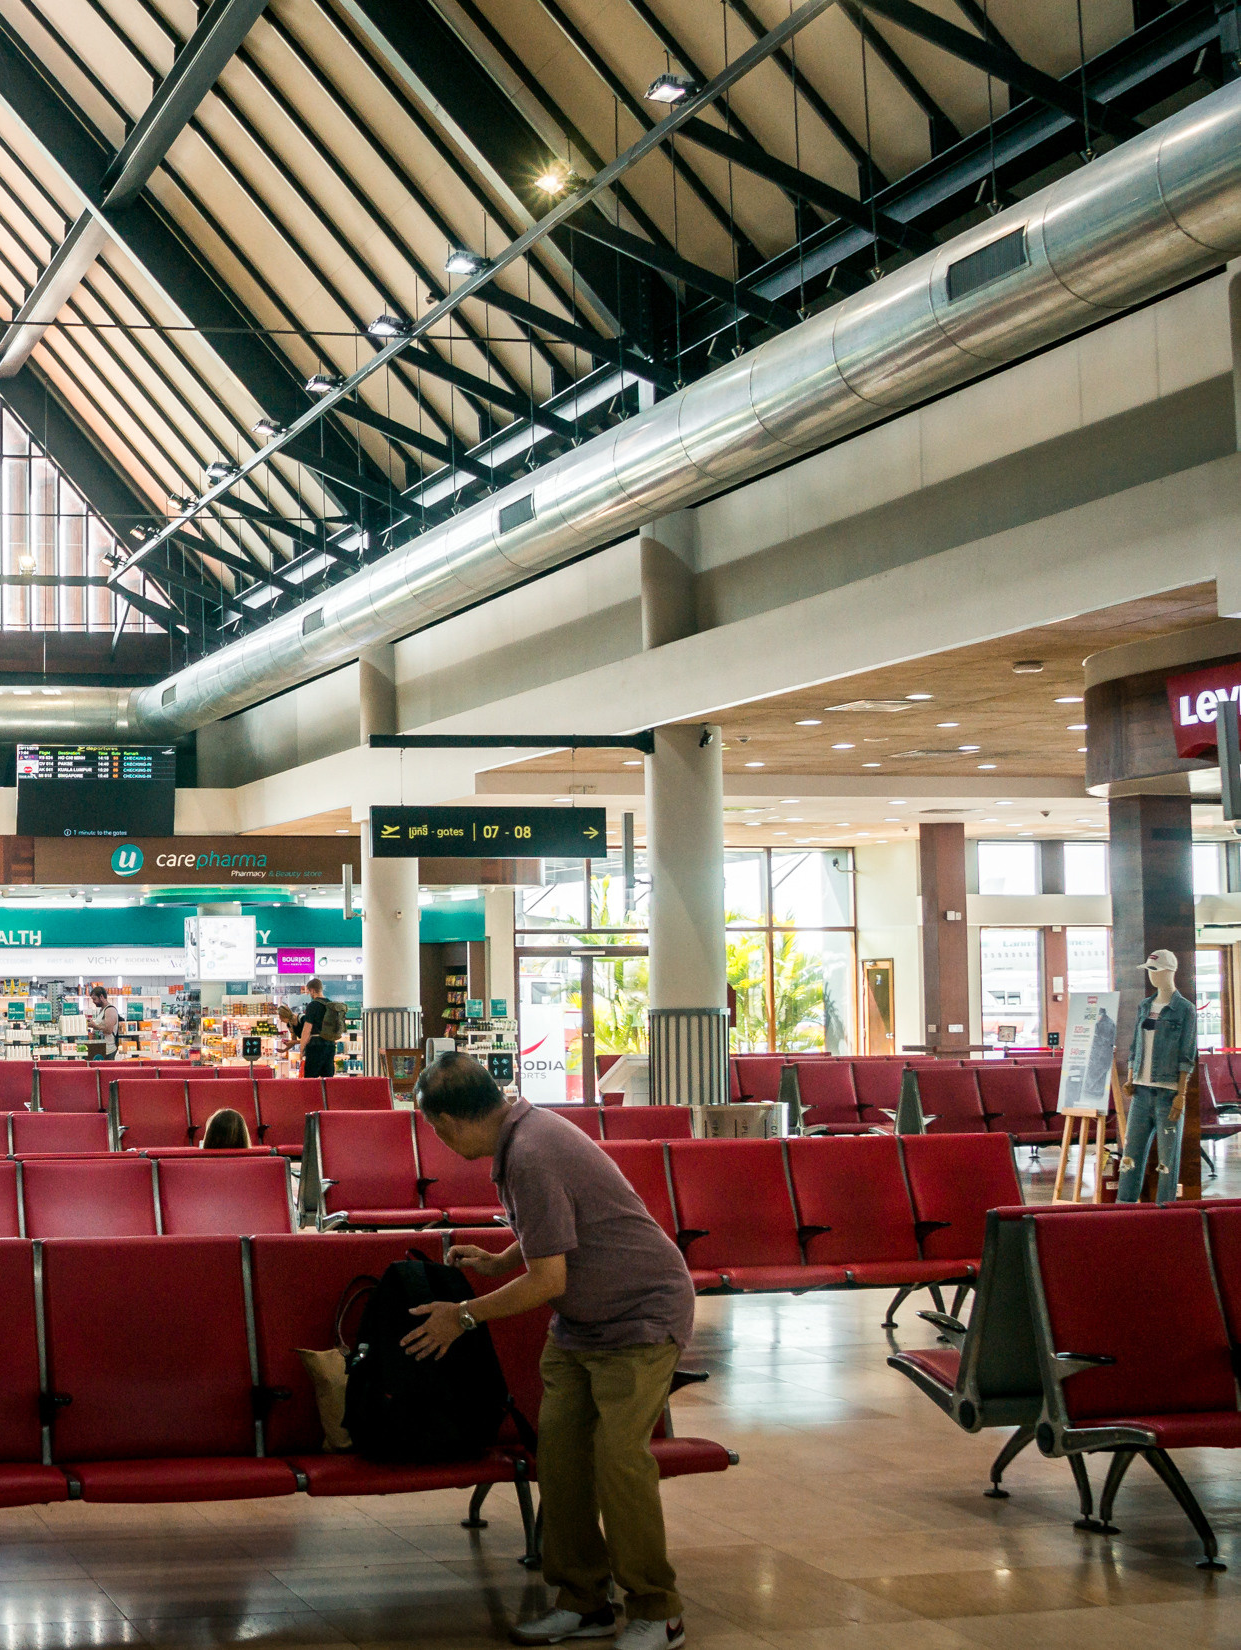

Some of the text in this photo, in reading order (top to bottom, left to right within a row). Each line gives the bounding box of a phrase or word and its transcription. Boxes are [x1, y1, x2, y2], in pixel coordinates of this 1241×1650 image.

[1180, 685, 1241, 726] Le
[437, 828, 464, 838] gates
[483, 826, 499, 838] 07
[514, 826, 532, 838] 08
[231, 870, 266, 878] Pharmacy
[275, 870, 301, 878] Beauty
[256, 930, 271, 945] Y
[88, 957, 119, 965] VICHY
[282, 956, 311, 964] BOURJOIS
[520, 1061, 565, 1070] ODIA
